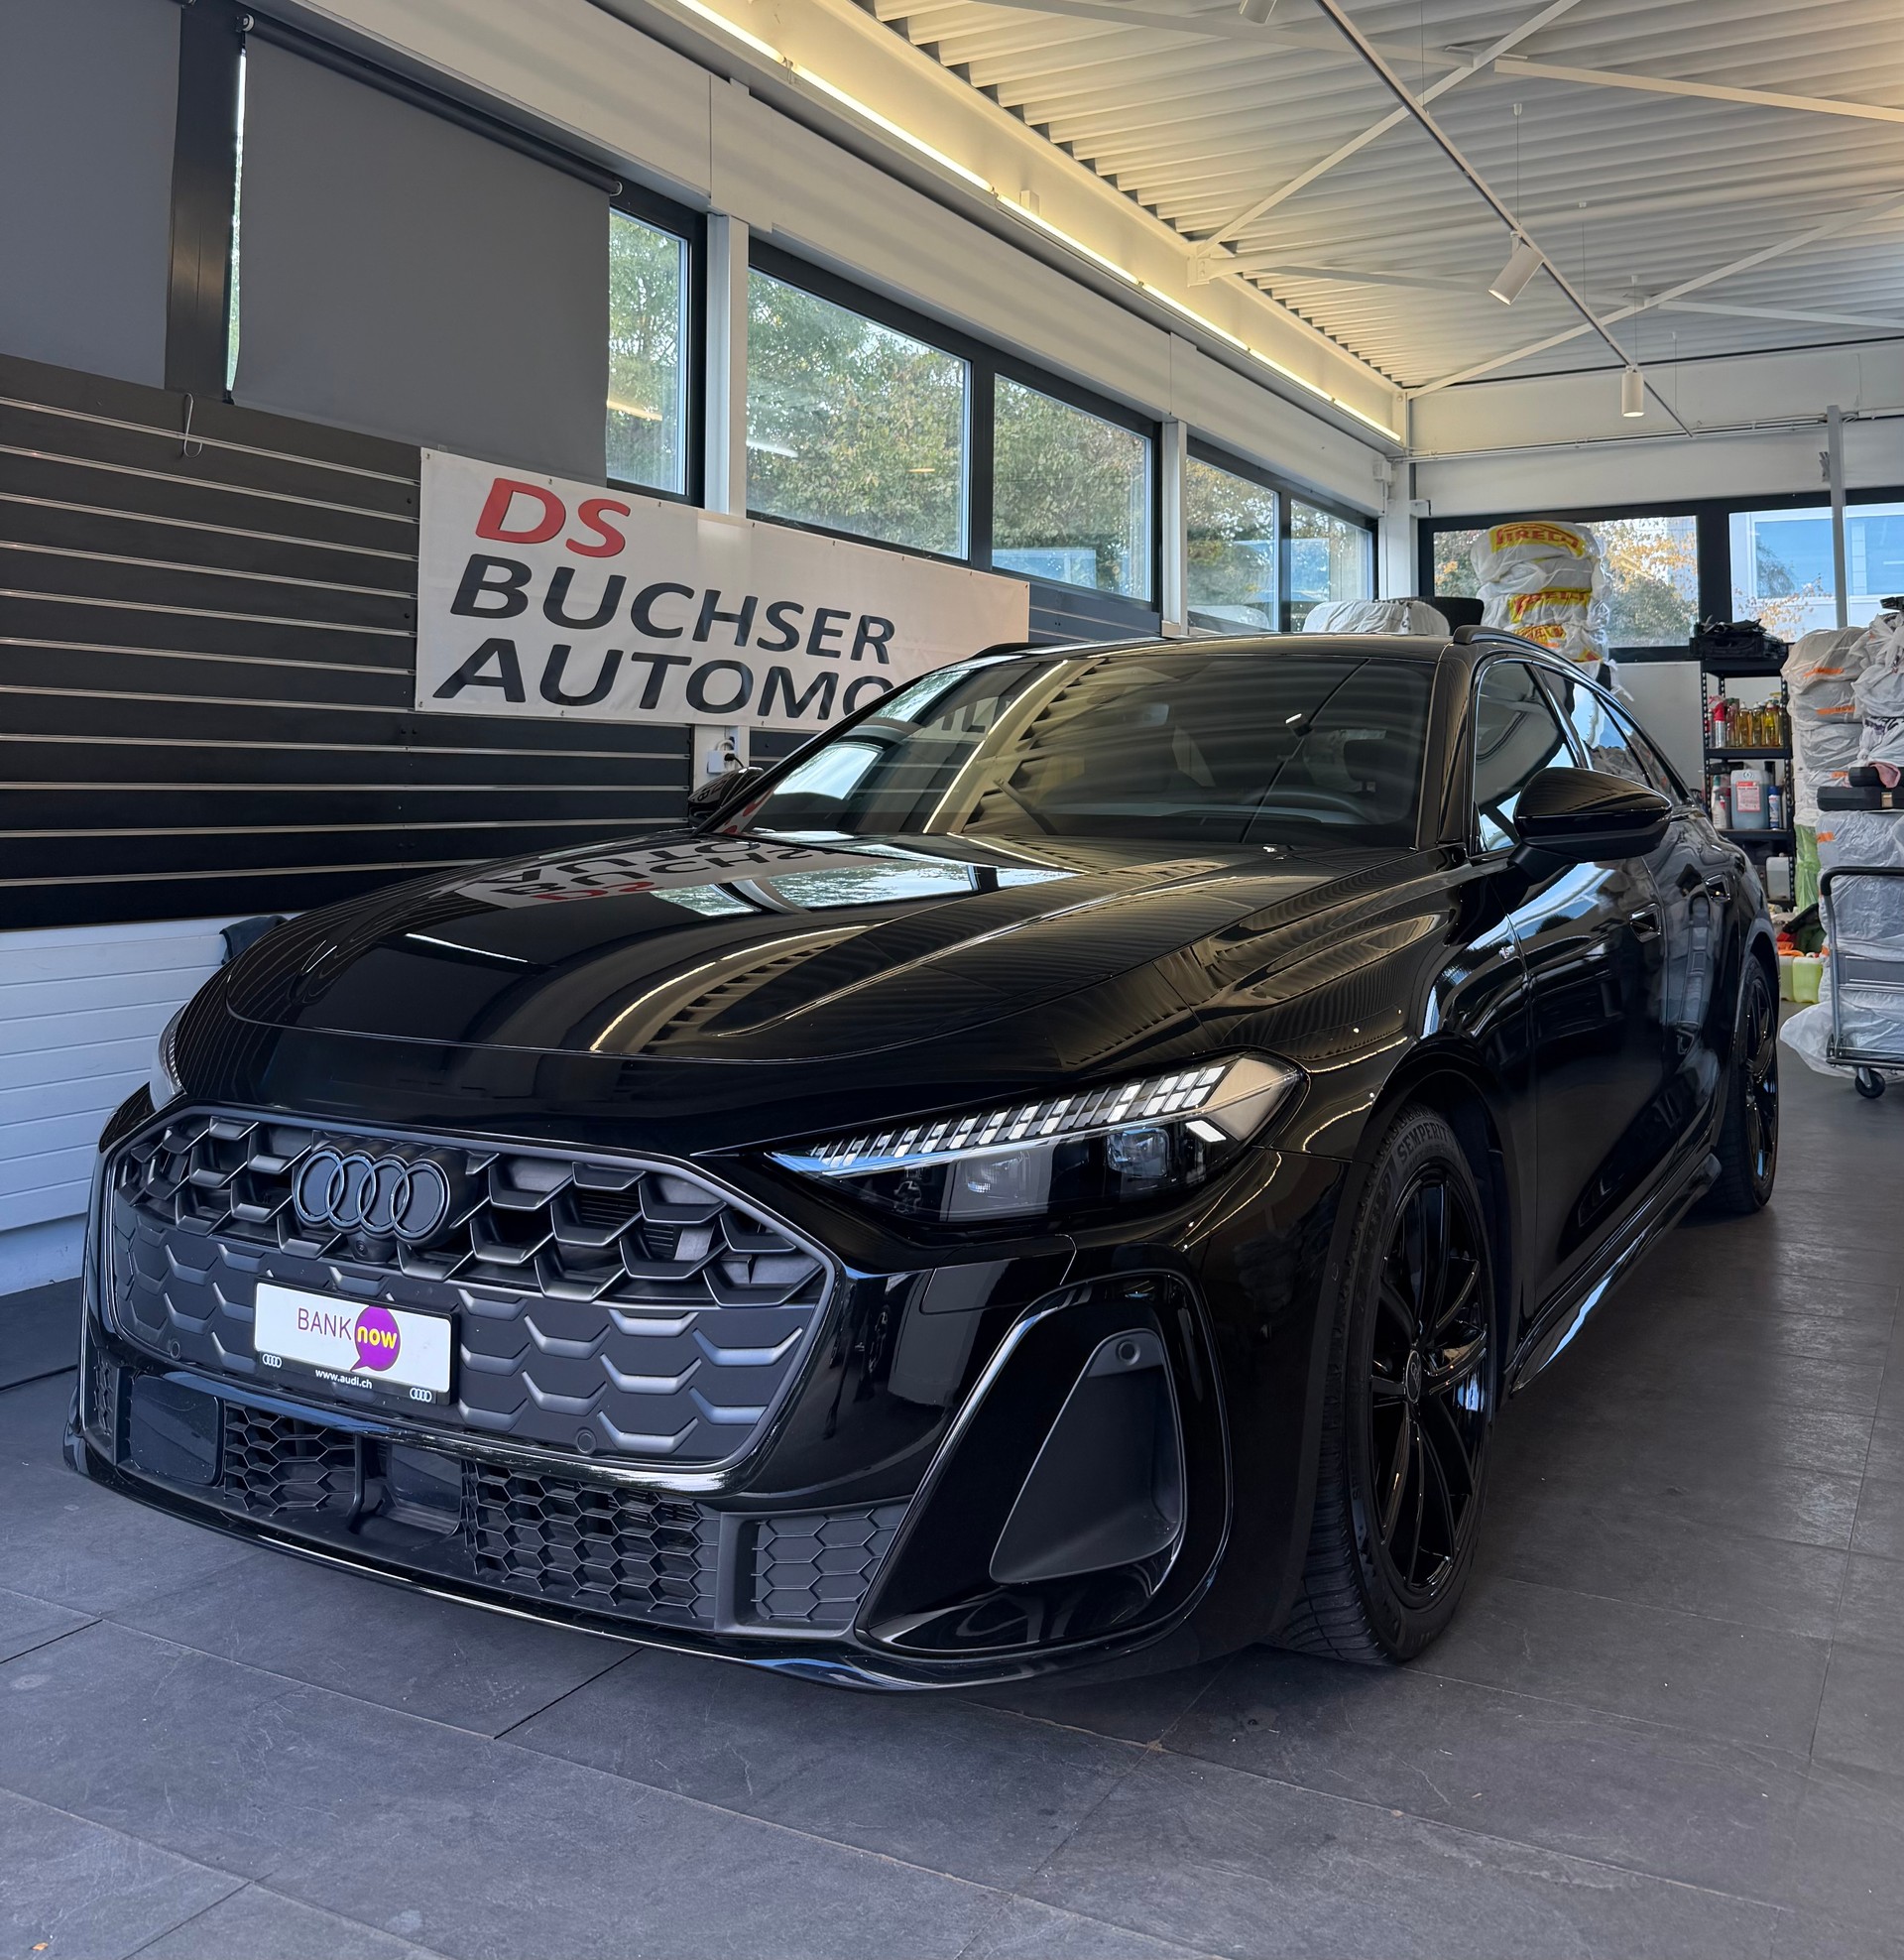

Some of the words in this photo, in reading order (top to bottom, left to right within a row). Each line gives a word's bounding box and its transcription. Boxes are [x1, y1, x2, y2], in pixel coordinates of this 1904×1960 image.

[475, 477, 631, 558] DS
[450, 553, 895, 665] BUCHSER
[1397, 1122, 1449, 1164] SEMPERIT
[298, 1307, 352, 1340] BANK
[357, 1325, 398, 1349] now
[315, 1368, 373, 1390] www.audi.ch
